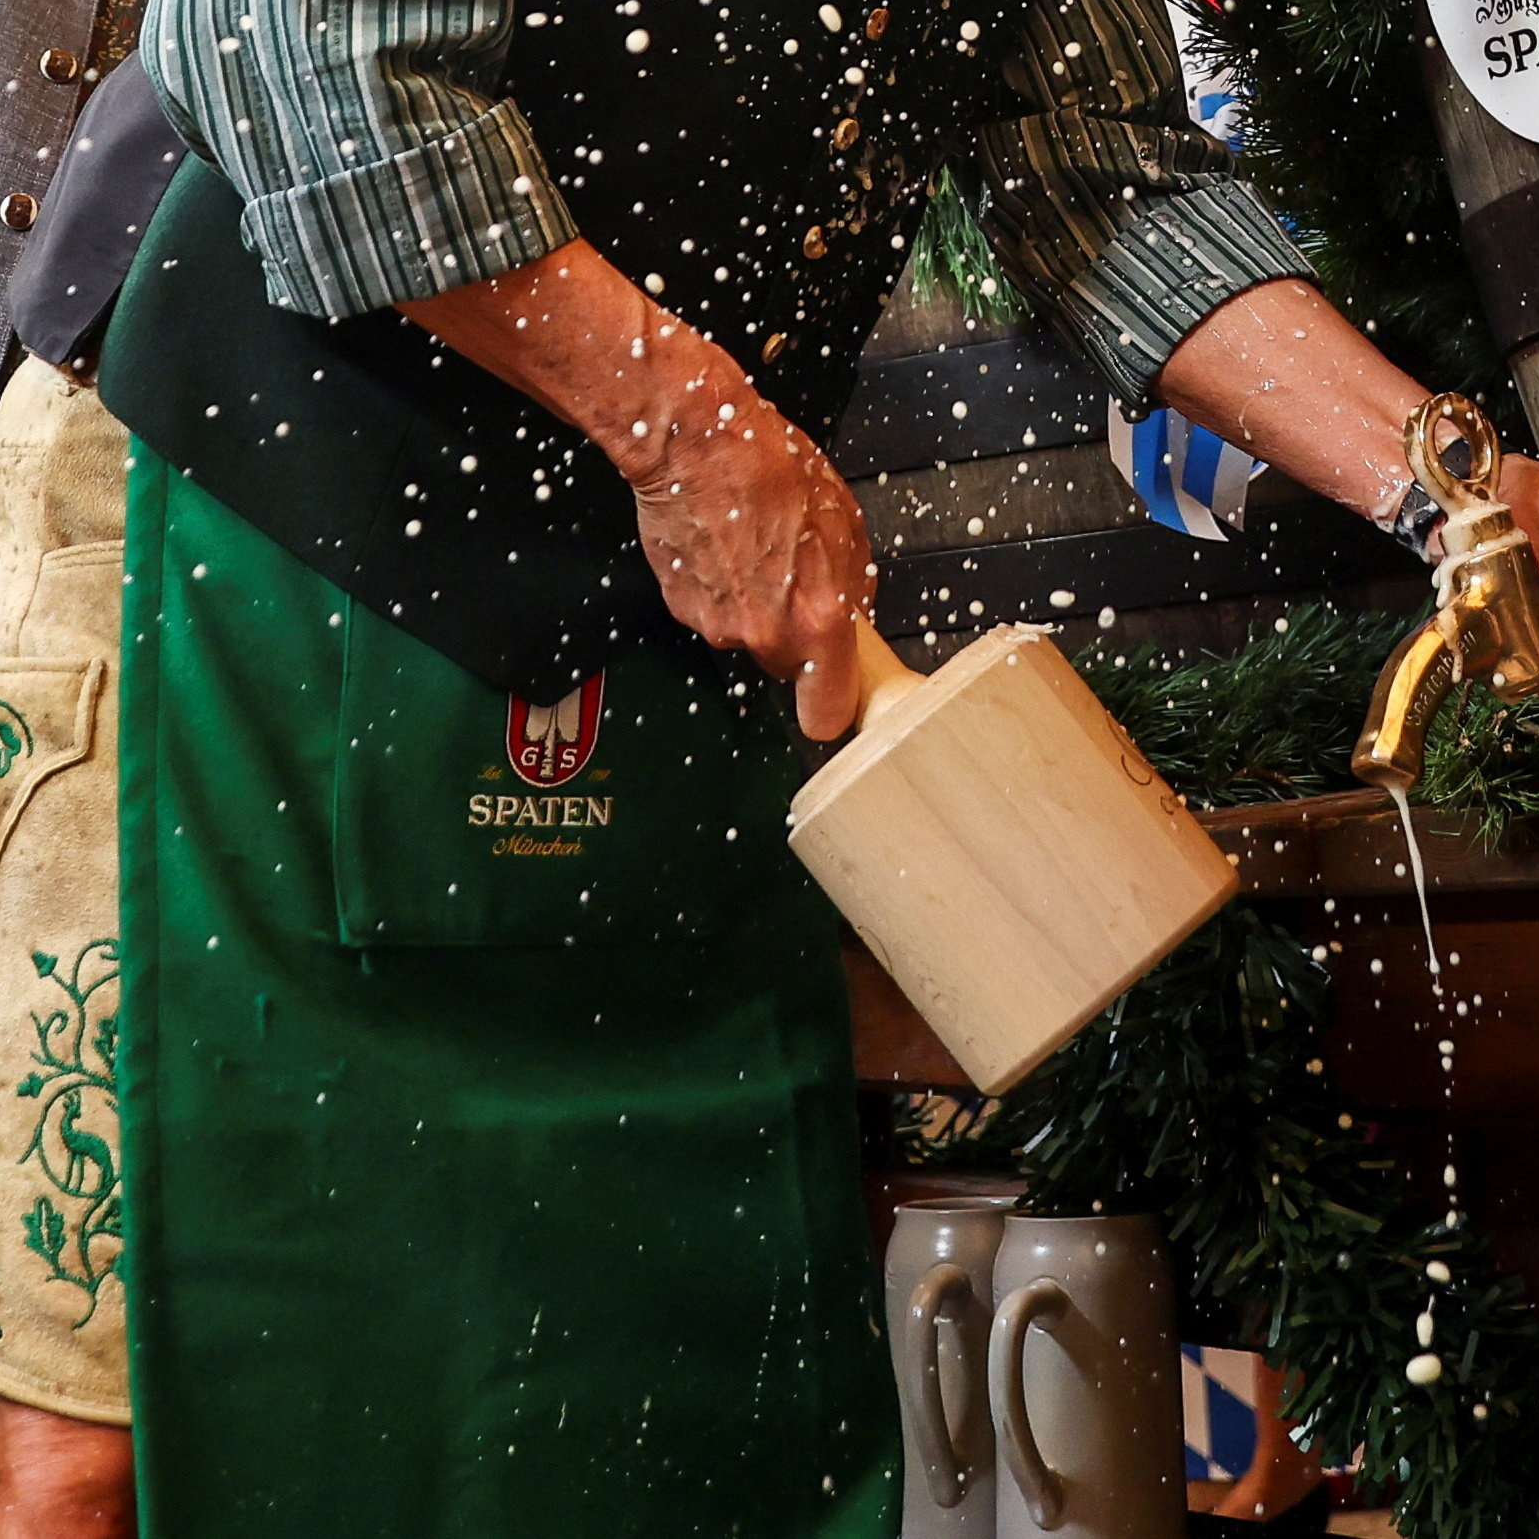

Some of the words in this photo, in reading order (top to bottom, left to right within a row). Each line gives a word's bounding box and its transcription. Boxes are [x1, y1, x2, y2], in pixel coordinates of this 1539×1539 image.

[520, 746, 540, 767] G
[559, 747, 578, 768] S
[468, 793, 615, 826] SPATEN
[492, 833, 584, 857] München
